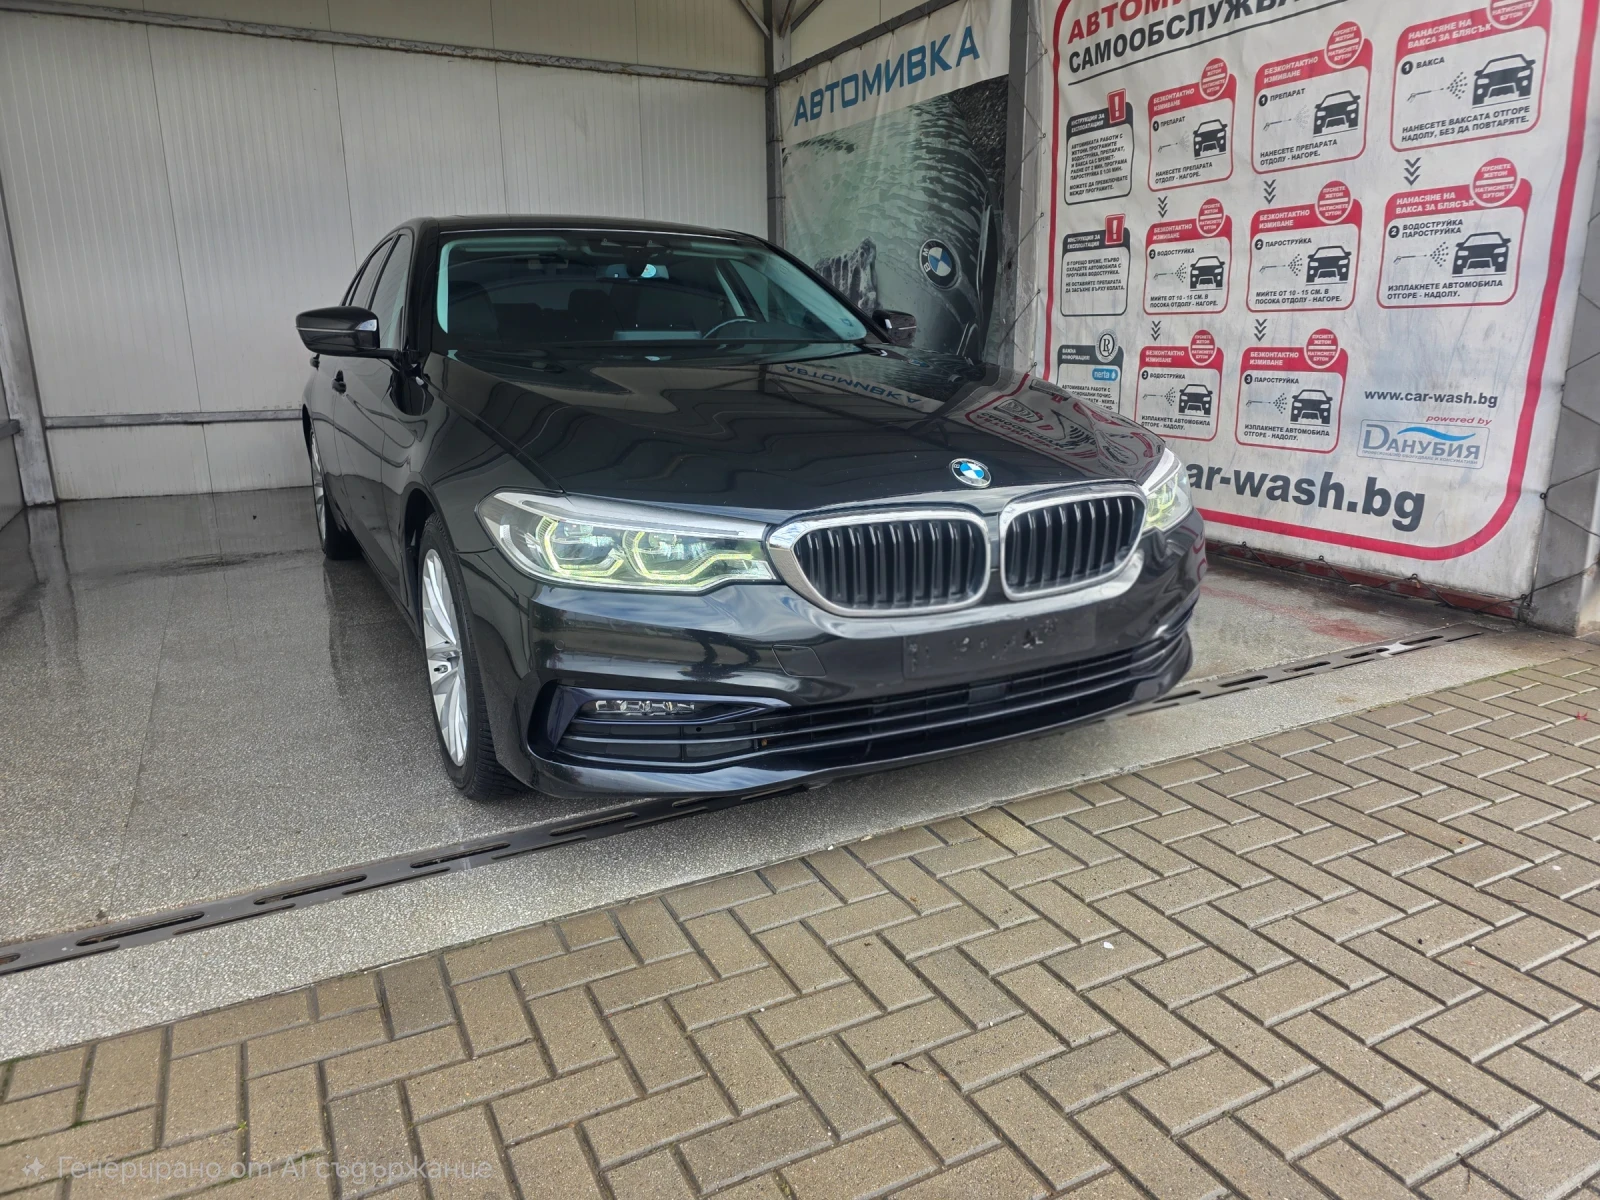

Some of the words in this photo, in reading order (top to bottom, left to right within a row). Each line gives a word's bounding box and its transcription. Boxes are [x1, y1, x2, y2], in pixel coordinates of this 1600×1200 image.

[1409, 22, 1457, 40] НАНАСЯНЕ
[1459, 19, 1473, 29] НА
[1408, 36, 1437, 49] ВАКСА
[1439, 33, 1450, 42] ЗА
[1453, 24, 1493, 39] БЛЯСЪК
[1265, 56, 1318, 75] БЕЗКОНТАКТНО
[1417, 57, 1445, 69] ВАКСА
[794, 26, 981, 126] АВТОМИВКА
[1264, 70, 1301, 84] ИЗМИВАНЕ
[1154, 89, 1195, 104] БЕЗКОНТАКТНО
[1270, 89, 1306, 102] ПРЕПАРАТ
[1154, 100, 1181, 112] ИЗМИВАНЕ
[1161, 117, 1185, 127] ПРЕПАРАТ
[1402, 120, 1447, 134] НАНЕСЕТЕ
[1449, 113, 1491, 126] ВАКСАТА
[1493, 106, 1531, 119] ОТГОРЕ
[1402, 130, 1437, 142] НАДОЛУ,
[1440, 127, 1455, 137] БЕЗ
[1457, 125, 1471, 134] ДА
[1473, 116, 1529, 131] ПОВТАРЯТЕ.
[1261, 147, 1294, 158] НАНЕСЕТЕ
[1296, 139, 1338, 152] ПРЕПАРАТА
[1261, 156, 1286, 166] ОТДОЛУ
[1292, 150, 1320, 161] НАГОРЕ.
[1156, 168, 1181, 177] НАНЕСЕТЕ
[1183, 162, 1213, 172] ПРЕПАРАТА
[1481, 164, 1511, 172] ПУСНЕТЕ
[1155, 176, 1175, 185] ОТДОЛУ
[1179, 172, 1201, 181] НАГОРЕ.
[1397, 194, 1441, 205] НАНАСЯНЕ
[1444, 192, 1456, 200] НА
[1396, 206, 1423, 215] ВАКСА
[1425, 204, 1436, 212] ЗА
[1438, 200, 1475, 211] БЛЯСЪК
[1260, 210, 1310, 221] БЕЗКОНТАКТНО
[1154, 224, 1192, 233] БЕЗКОНТАКТНО
[1259, 220, 1294, 229] ИЗМИВАНЕ
[1403, 219, 1463, 231] ВОДОСТРУЙКА
[1402, 228, 1462, 239] ПАРОСТРУЙКА
[1266, 238, 1312, 247] ПАРОСТРУЙКА
[1388, 283, 1440, 292] ИЗПЛАКНЕТЕ
[1442, 280, 1503, 289] АВТОМОБИЛА
[1388, 292, 1418, 300] ОТГОРЕ
[1425, 291, 1460, 299] НАДОЛУ.
[1094, 371, 1110, 379] nerta
[1365, 391, 1499, 409] www.car-wash.bg
[1175, 418, 1210, 426] АВТОМОБИЛА
[1426, 416, 1475, 426] powered
[1478, 418, 1493, 427] by
[1245, 425, 1284, 433] ИЗПЛАКНЕТЕ
[1286, 428, 1330, 437] АВТОМОБИЛА
[1186, 464, 1426, 532] ar-wash.bg
